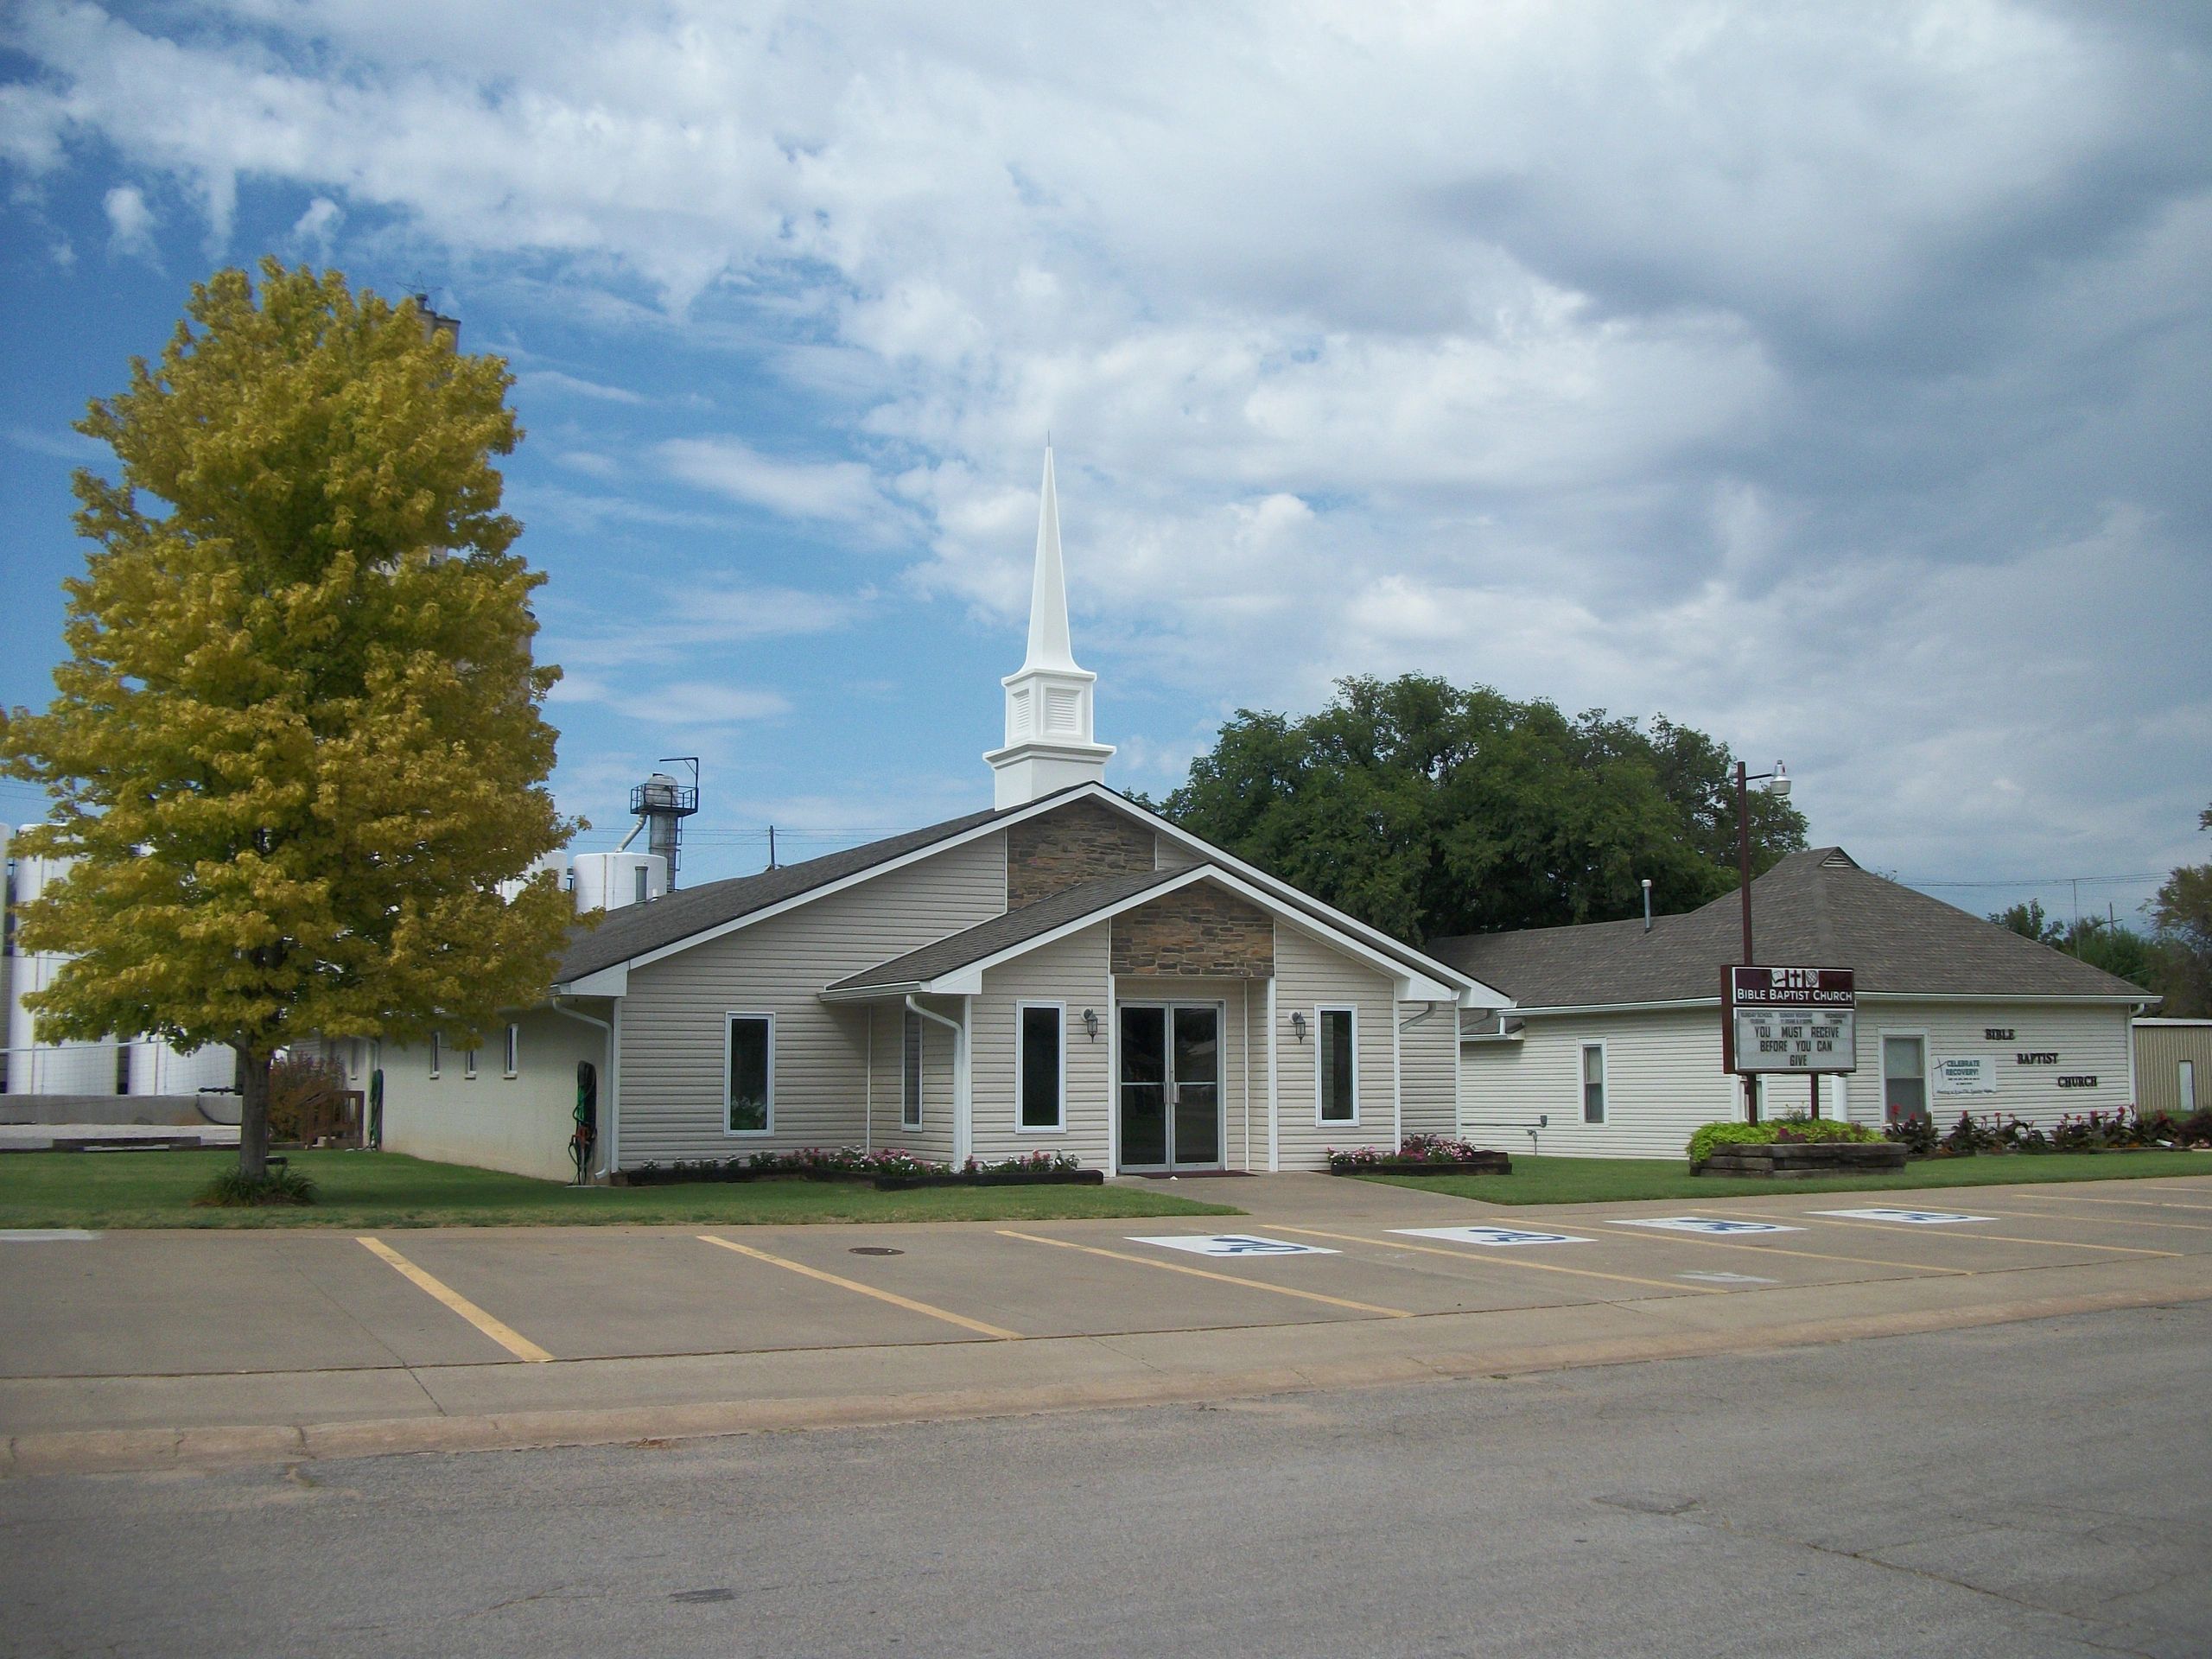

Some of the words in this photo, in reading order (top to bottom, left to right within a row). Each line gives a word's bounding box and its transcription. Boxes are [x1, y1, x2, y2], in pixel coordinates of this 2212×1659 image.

[1737, 988, 1766, 1000] BIBLE
[1769, 988, 1809, 1000] BAPTIST
[1813, 989, 1853, 1001] CHURCH
[1754, 1026, 1770, 1038] YOU
[1781, 1026, 1802, 1038] MUST
[1810, 1026, 1840, 1038] RECEIVE
[1985, 1029, 2015, 1040] BIBLE
[1759, 1040, 1788, 1052] BEFORE
[1796, 1040, 1811, 1052] YOU
[1816, 1040, 1833, 1052] CAN
[1789, 1054, 1808, 1066] GIVE
[2017, 1052, 2059, 1065] BAPTIST
[2057, 1076, 2098, 1088] CHURCH
